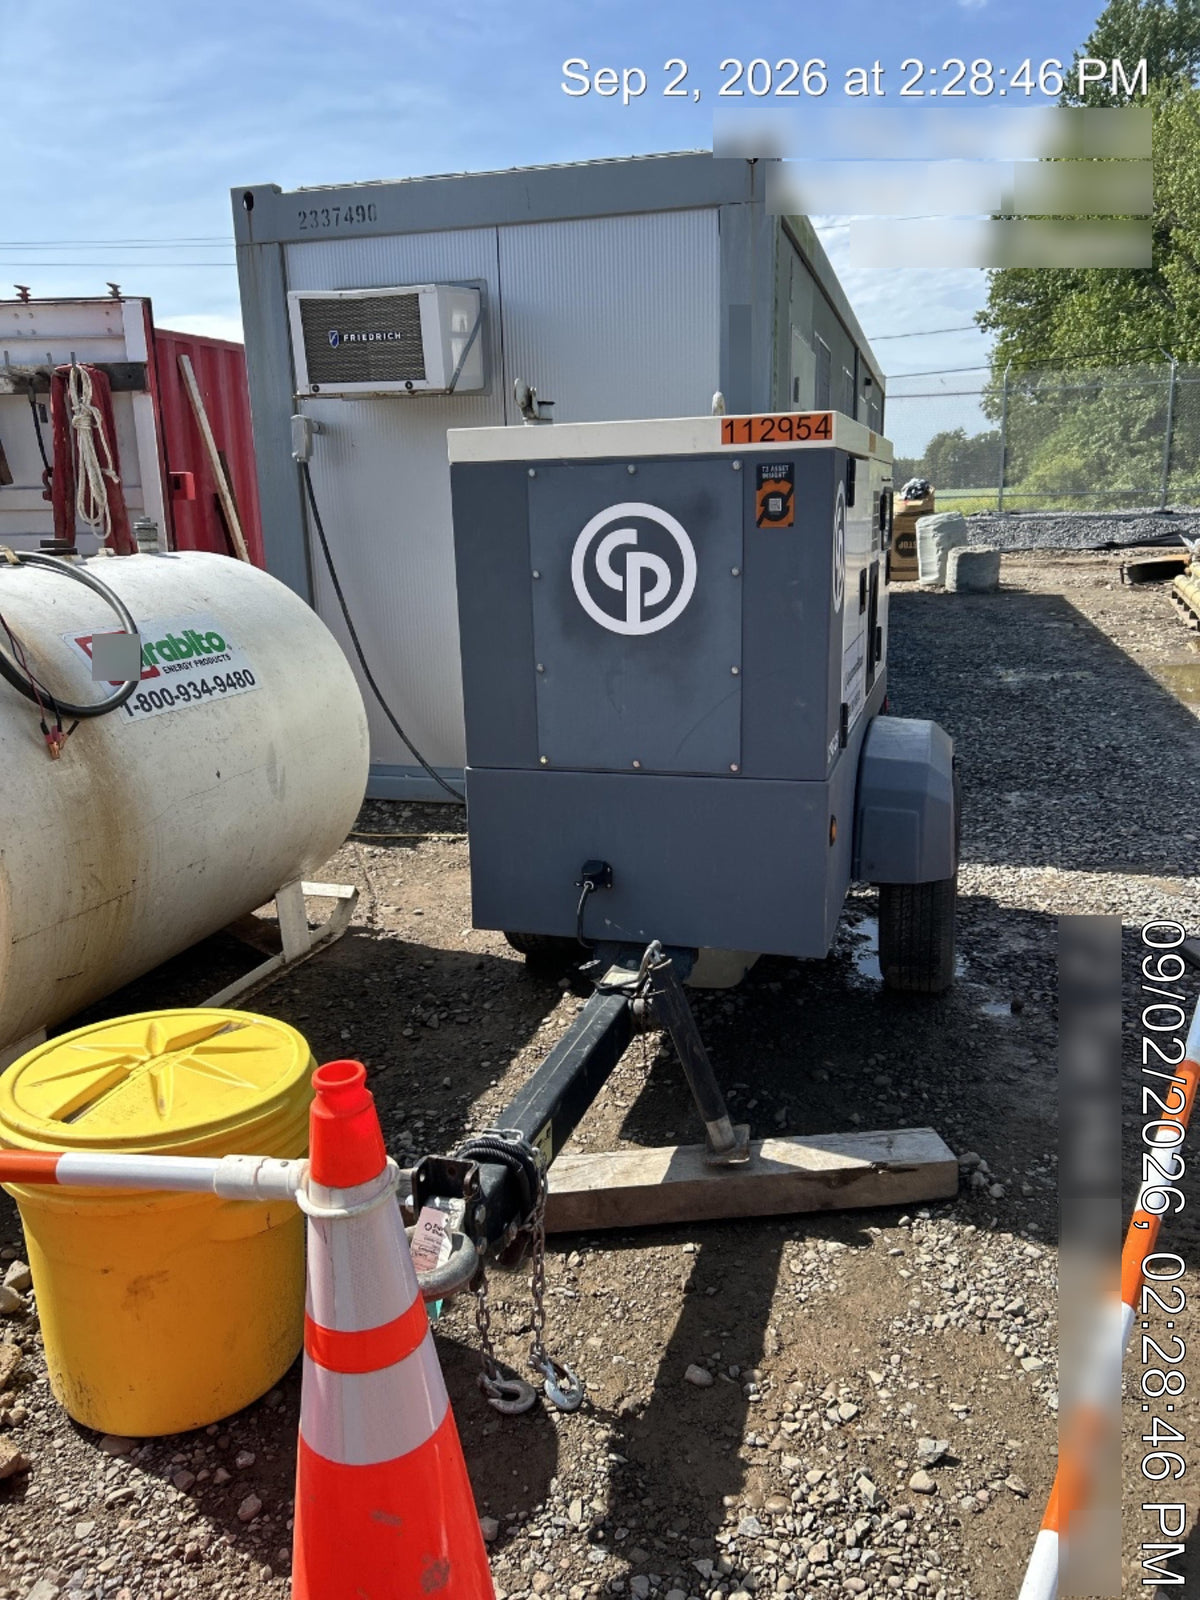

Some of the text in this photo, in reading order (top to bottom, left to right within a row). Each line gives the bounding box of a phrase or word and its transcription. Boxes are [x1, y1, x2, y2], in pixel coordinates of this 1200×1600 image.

[343, 331, 401, 342] FRIEDRICH
[725, 414, 831, 444] 112954
[141, 630, 226, 667] rabito
[162, 653, 232, 674] ENERGY PRODUCTS
[121, 669, 256, 716] 1-800-934-9480
